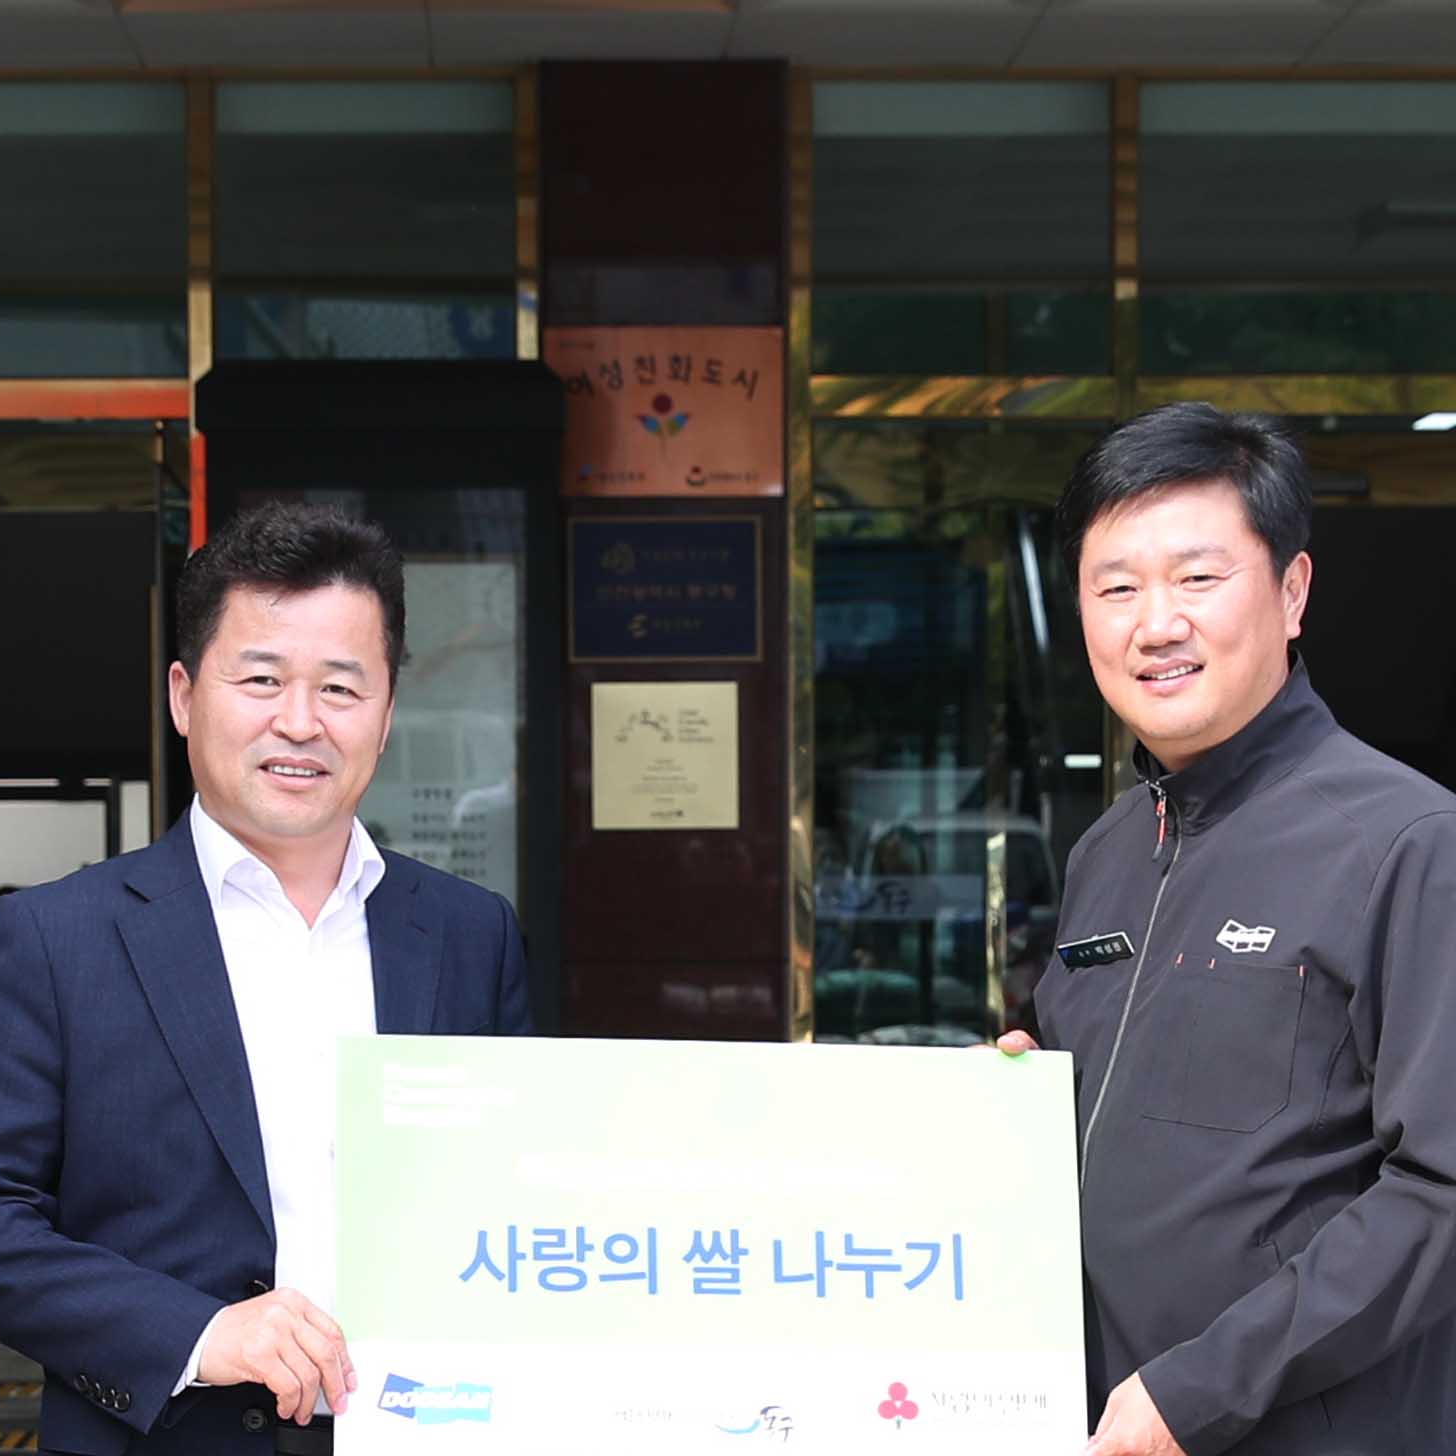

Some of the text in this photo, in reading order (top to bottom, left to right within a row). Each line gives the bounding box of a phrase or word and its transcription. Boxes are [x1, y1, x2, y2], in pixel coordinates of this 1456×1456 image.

[457, 1225, 967, 1300] 사랑의 쌀 나누기
